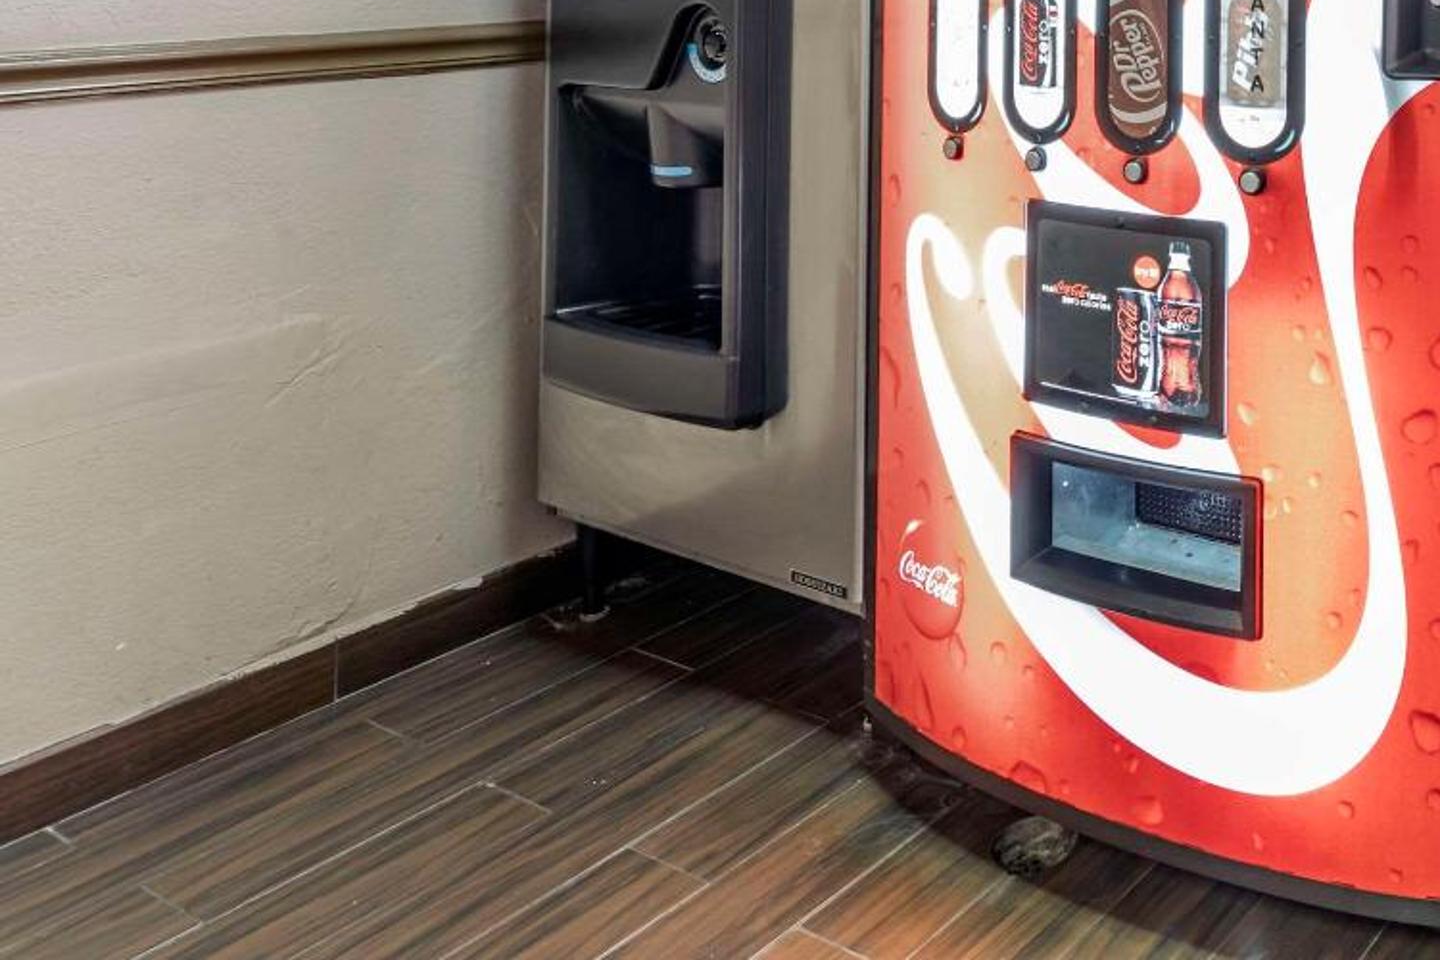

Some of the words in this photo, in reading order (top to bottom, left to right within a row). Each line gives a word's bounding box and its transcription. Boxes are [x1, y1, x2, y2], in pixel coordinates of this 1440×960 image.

[1111, 41, 1137, 75] Dr
[1121, 17, 1162, 101] Pepper
[1116, 298, 1140, 384] Coca-Cola
[898, 550, 961, 608] Coca-Cola
